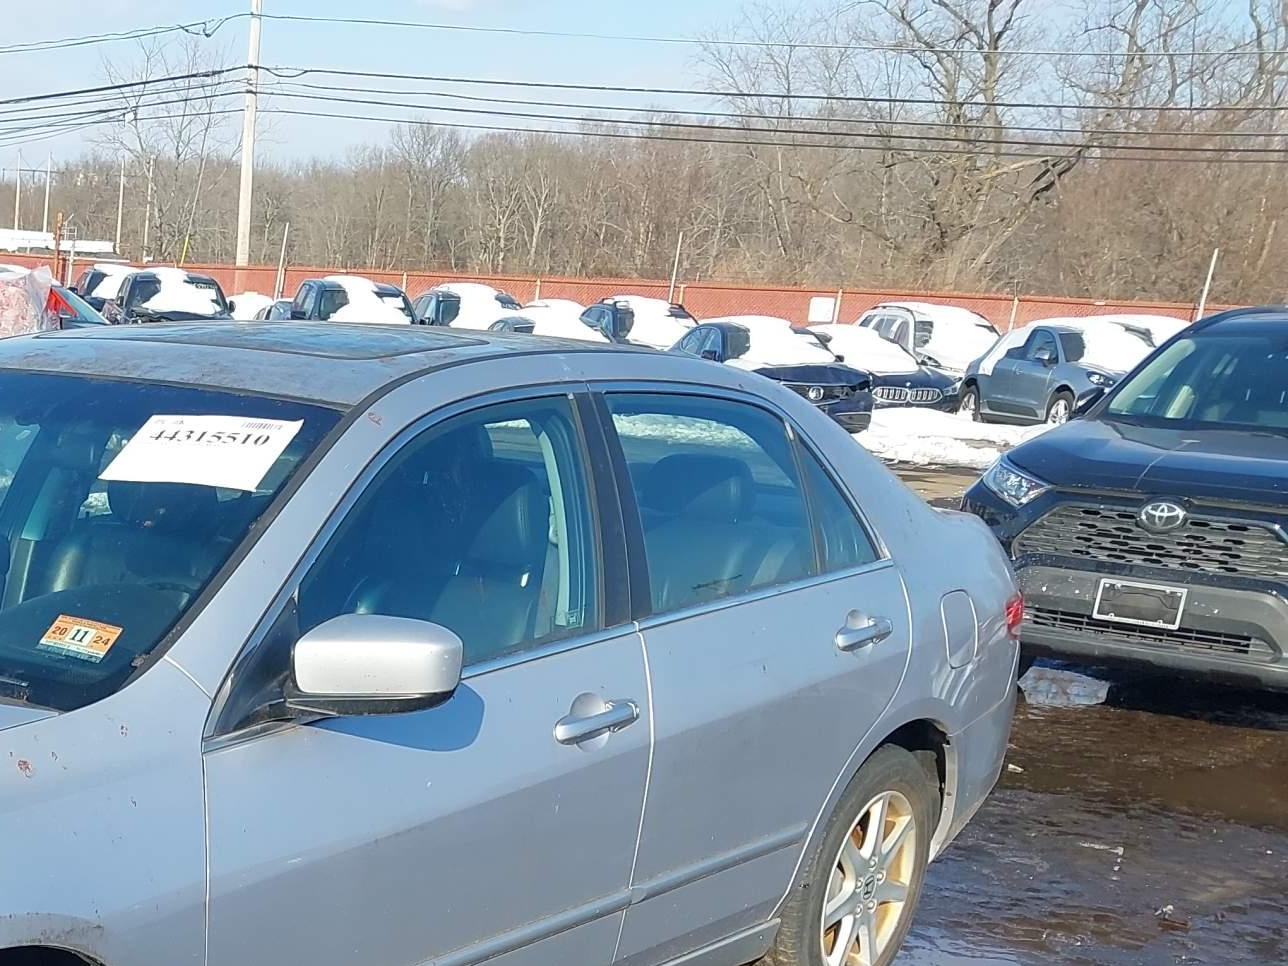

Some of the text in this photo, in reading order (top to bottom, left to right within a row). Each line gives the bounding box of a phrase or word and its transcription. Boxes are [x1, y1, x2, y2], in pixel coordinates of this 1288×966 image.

[149, 429, 271, 446] 44315510
[52, 625, 111, 646] 20 11 24
